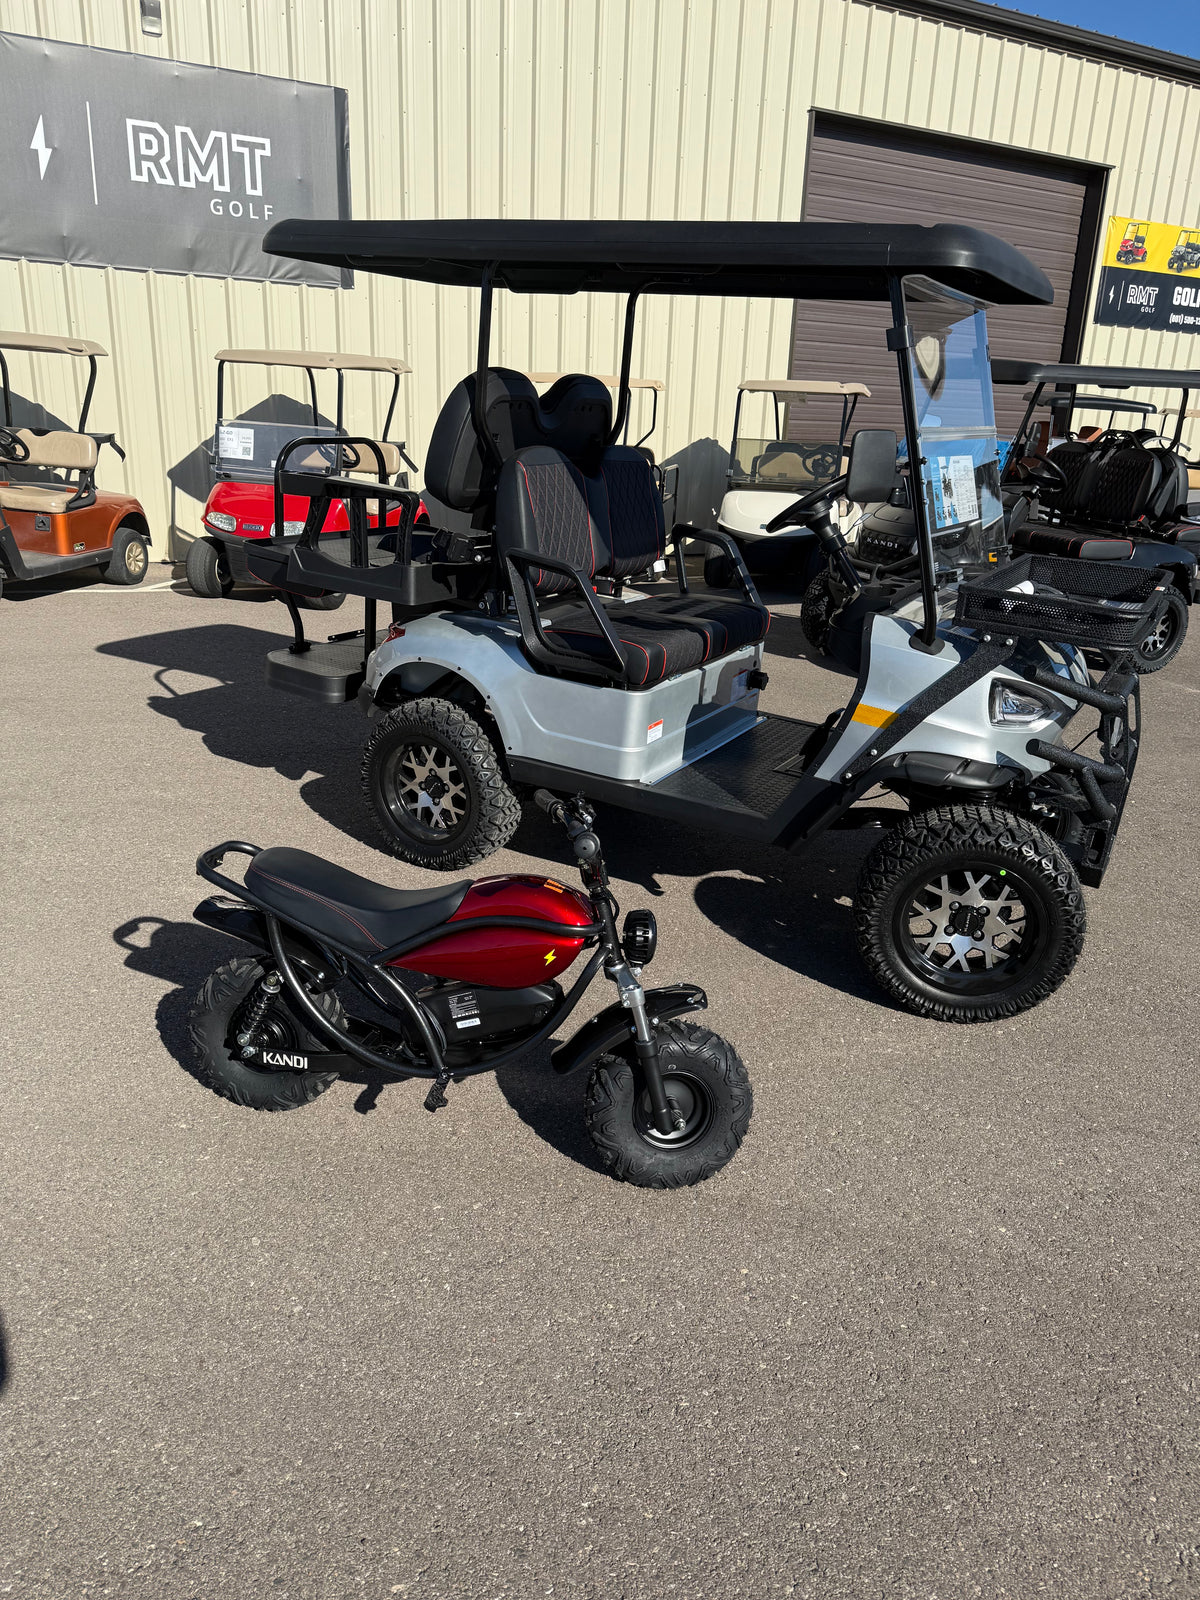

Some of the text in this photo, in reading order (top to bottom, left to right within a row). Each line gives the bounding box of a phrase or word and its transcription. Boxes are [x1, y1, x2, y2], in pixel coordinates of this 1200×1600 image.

[126, 118, 271, 196] RMT
[210, 198, 274, 220] GOLF
[1126, 284, 1159, 306] RMT
[866, 537, 898, 549] KANDI
[263, 1051, 308, 1069] KANDI
